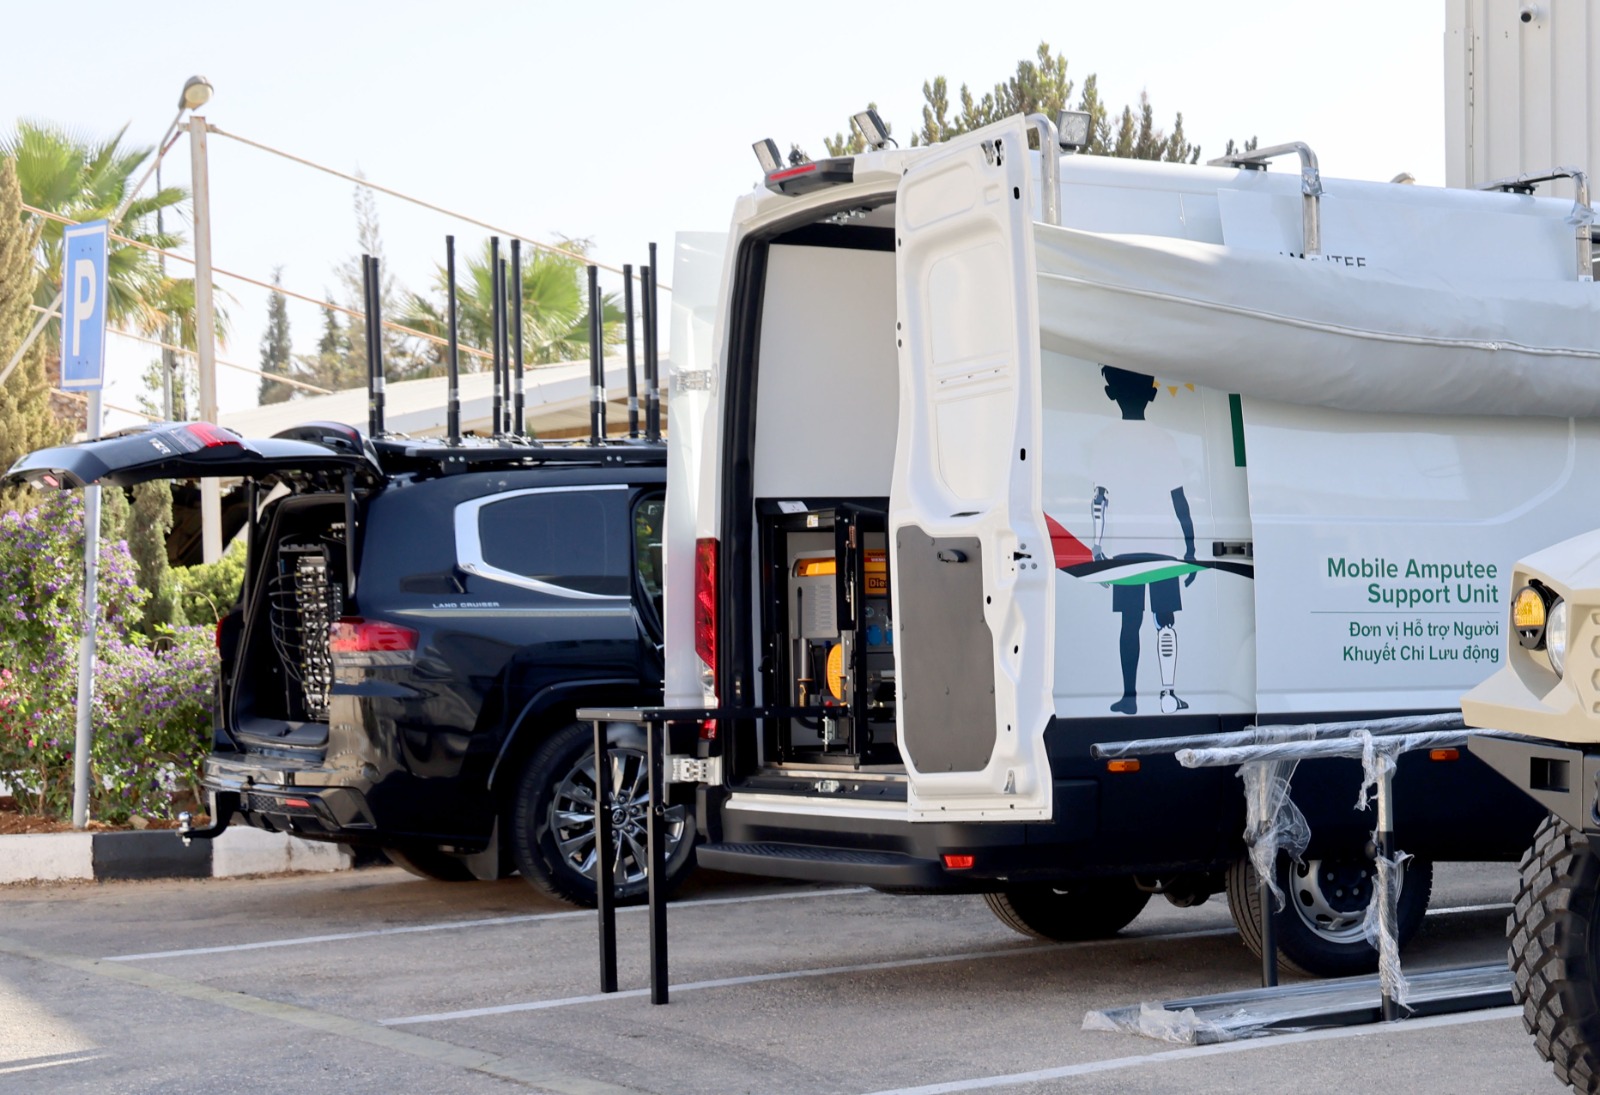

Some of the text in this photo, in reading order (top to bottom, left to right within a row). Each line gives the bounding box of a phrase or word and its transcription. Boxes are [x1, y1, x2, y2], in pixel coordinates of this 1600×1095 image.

[73, 259, 96, 356] P
[1328, 557, 1497, 583] Mobile Amputee
[1368, 583, 1498, 608] Support Unit
[1348, 618, 1498, 640] Đơn vị Hỗ trợ Người
[1343, 641, 1499, 664] Khuyết Chi Lưu động
